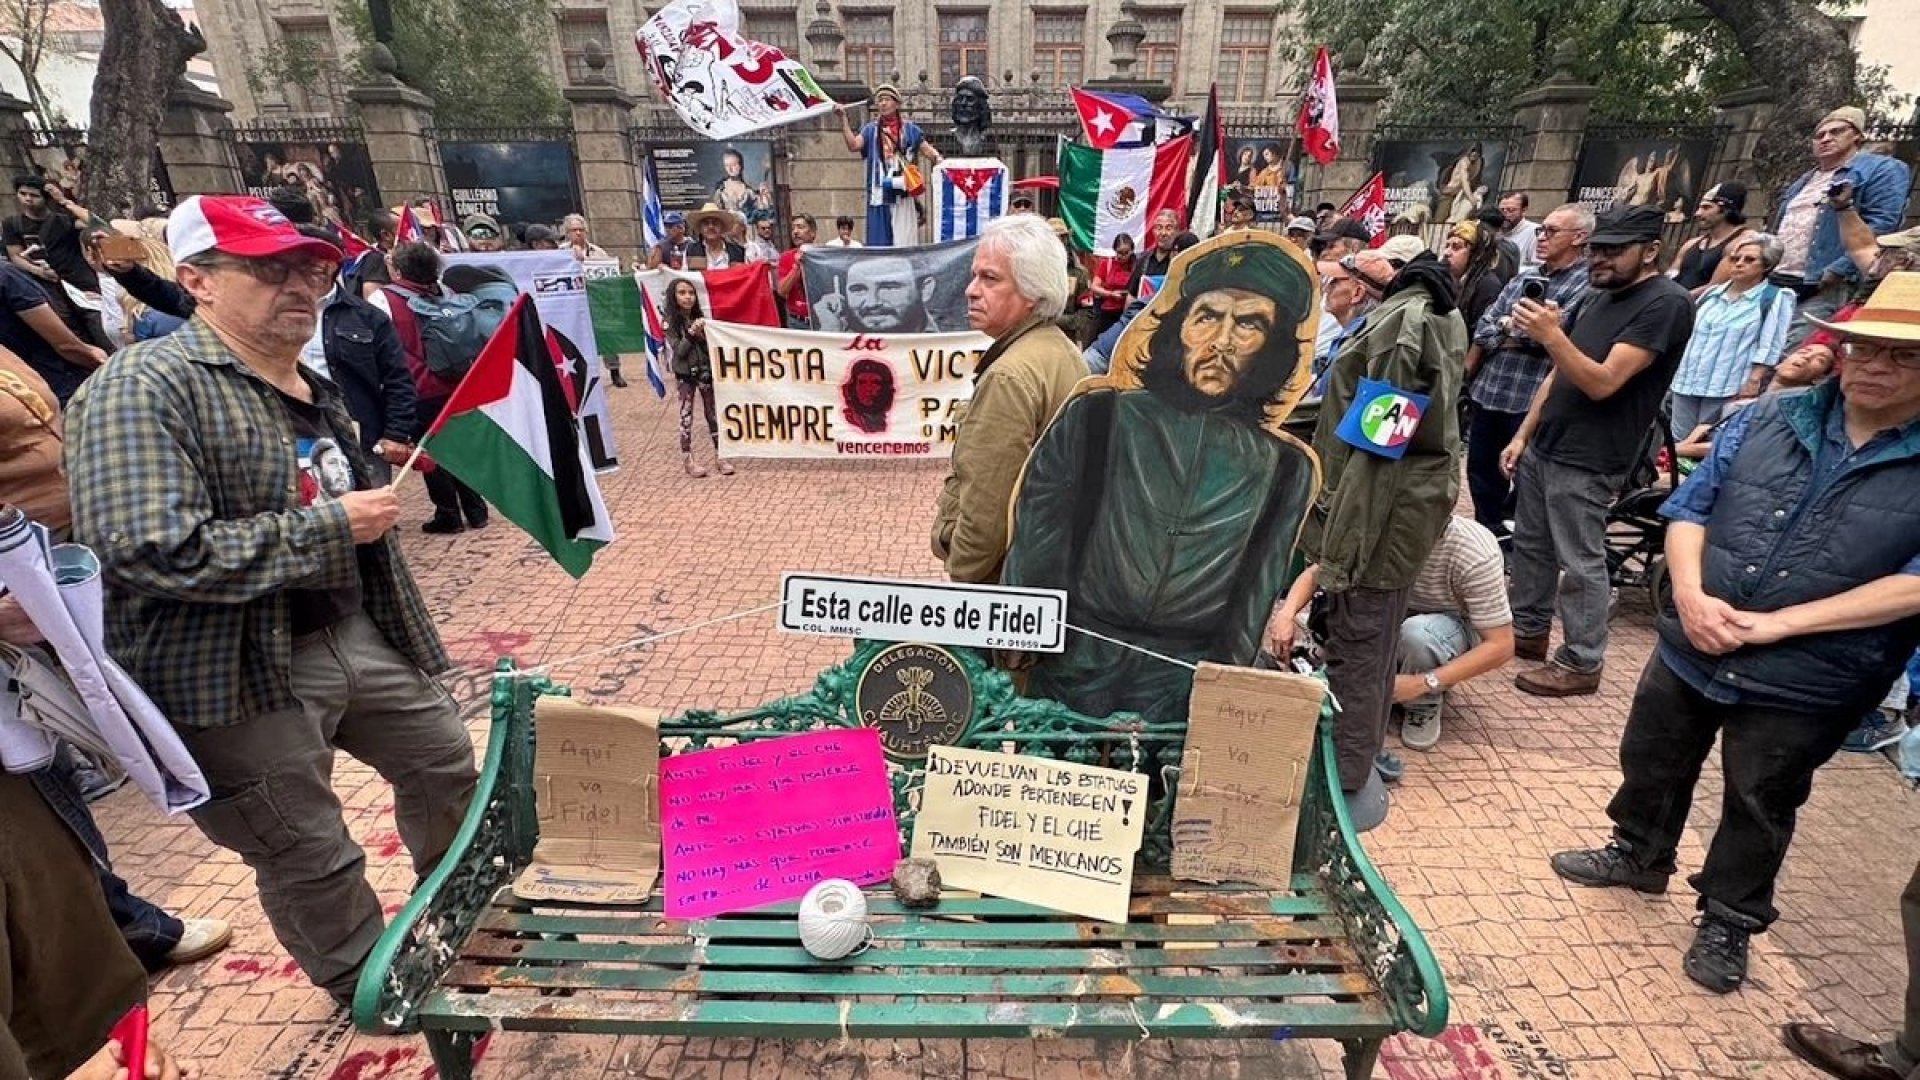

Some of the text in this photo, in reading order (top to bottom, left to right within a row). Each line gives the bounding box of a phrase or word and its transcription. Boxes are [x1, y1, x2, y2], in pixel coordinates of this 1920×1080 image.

[716, 346, 827, 383] HASTA
[843, 333, 889, 351] la
[724, 403, 835, 443] SIEMPRE
[1365, 403, 1417, 438] PAN
[837, 441, 931, 454] venceremos
[801, 588, 1044, 636] Esta calle es de Fidel
[802, 622, 828, 634] COL.
[952, 779, 1011, 798] ADONDE
[1046, 768, 1071, 786] LAS
[1078, 774, 1138, 795] ESTATUAS
[561, 802, 620, 824] Fidel
[979, 805, 1103, 841] FIDEL Y EL CHÉ
[928, 831, 1122, 875] TAMBIÉN SON MEXICANOS
